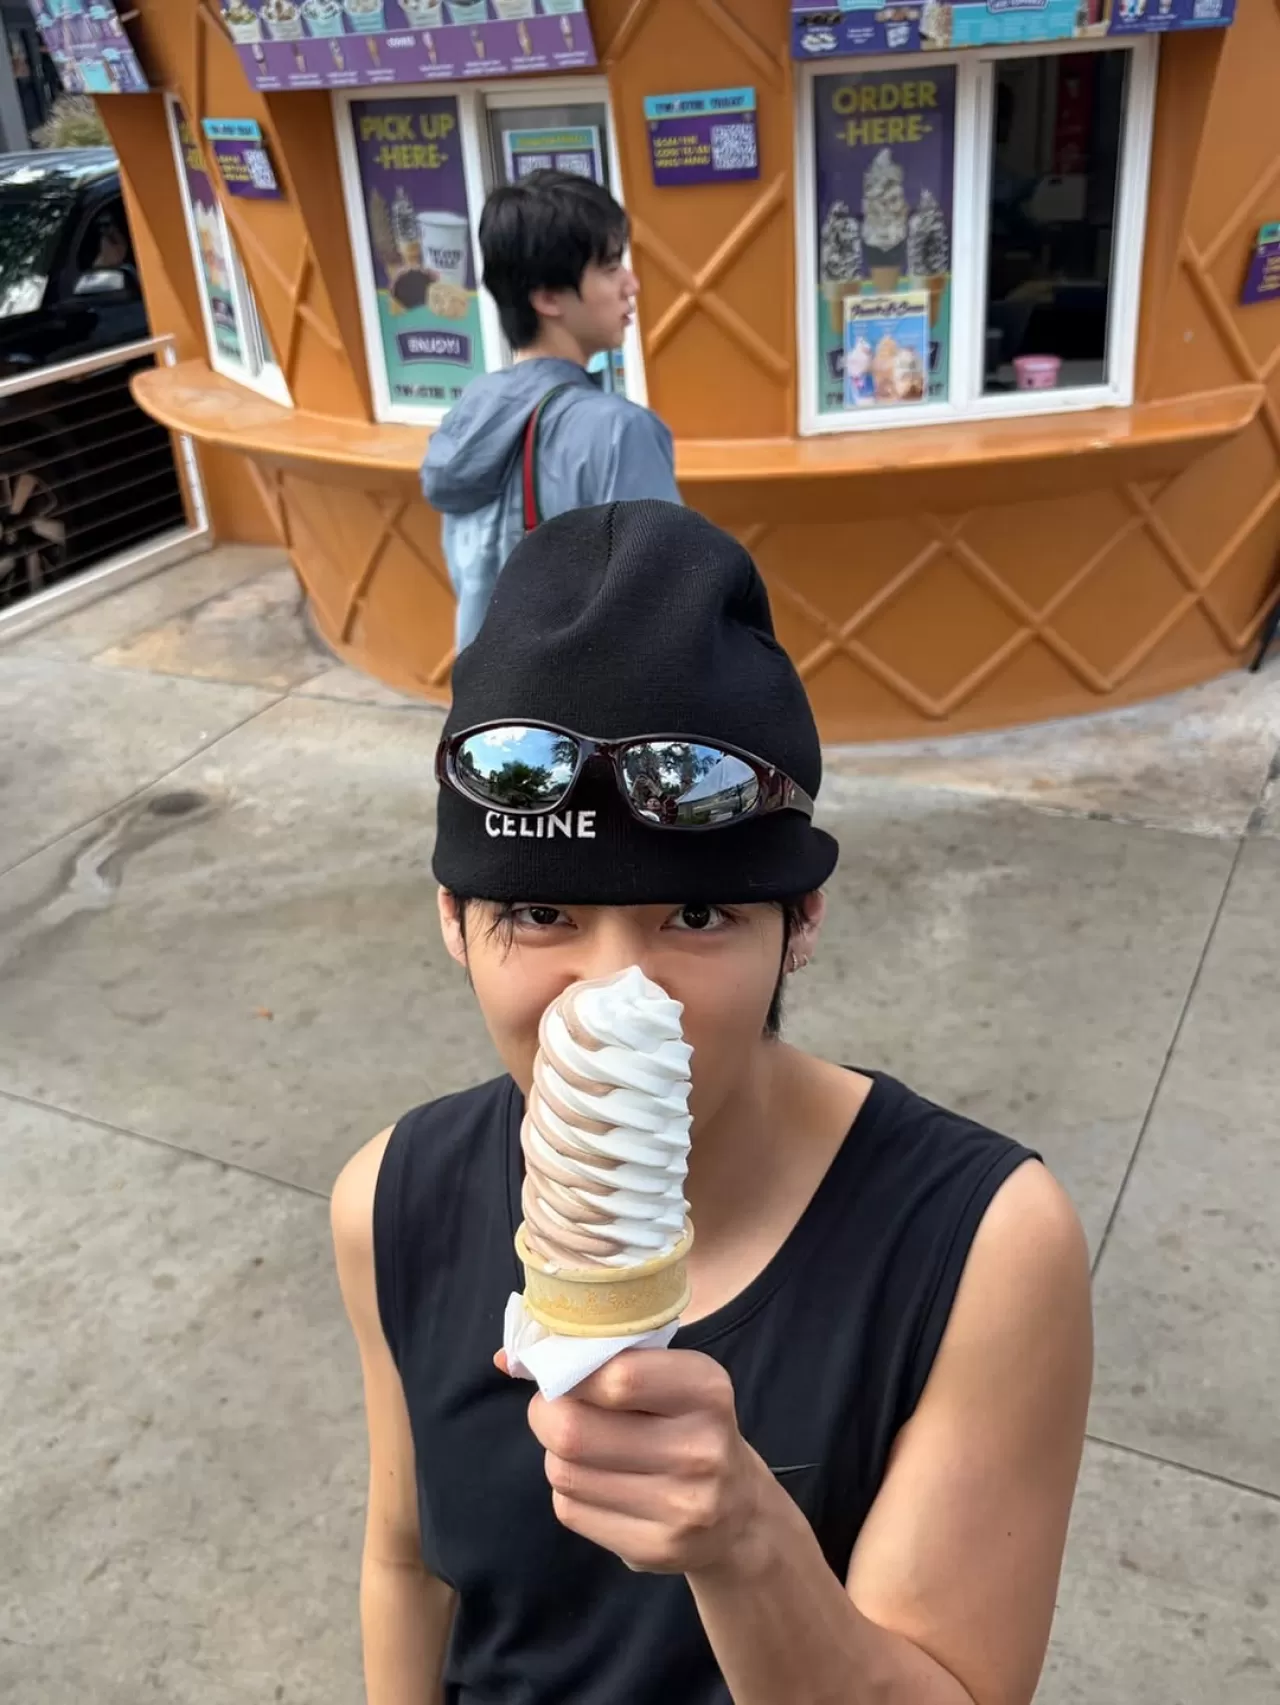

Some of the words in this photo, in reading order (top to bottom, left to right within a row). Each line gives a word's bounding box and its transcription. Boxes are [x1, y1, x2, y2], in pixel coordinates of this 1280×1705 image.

[832, 81, 938, 114] ORDER
[361, 114, 416, 141] PICK
[421, 113, 455, 139] UP
[485, 810, 597, 838] CELINE
